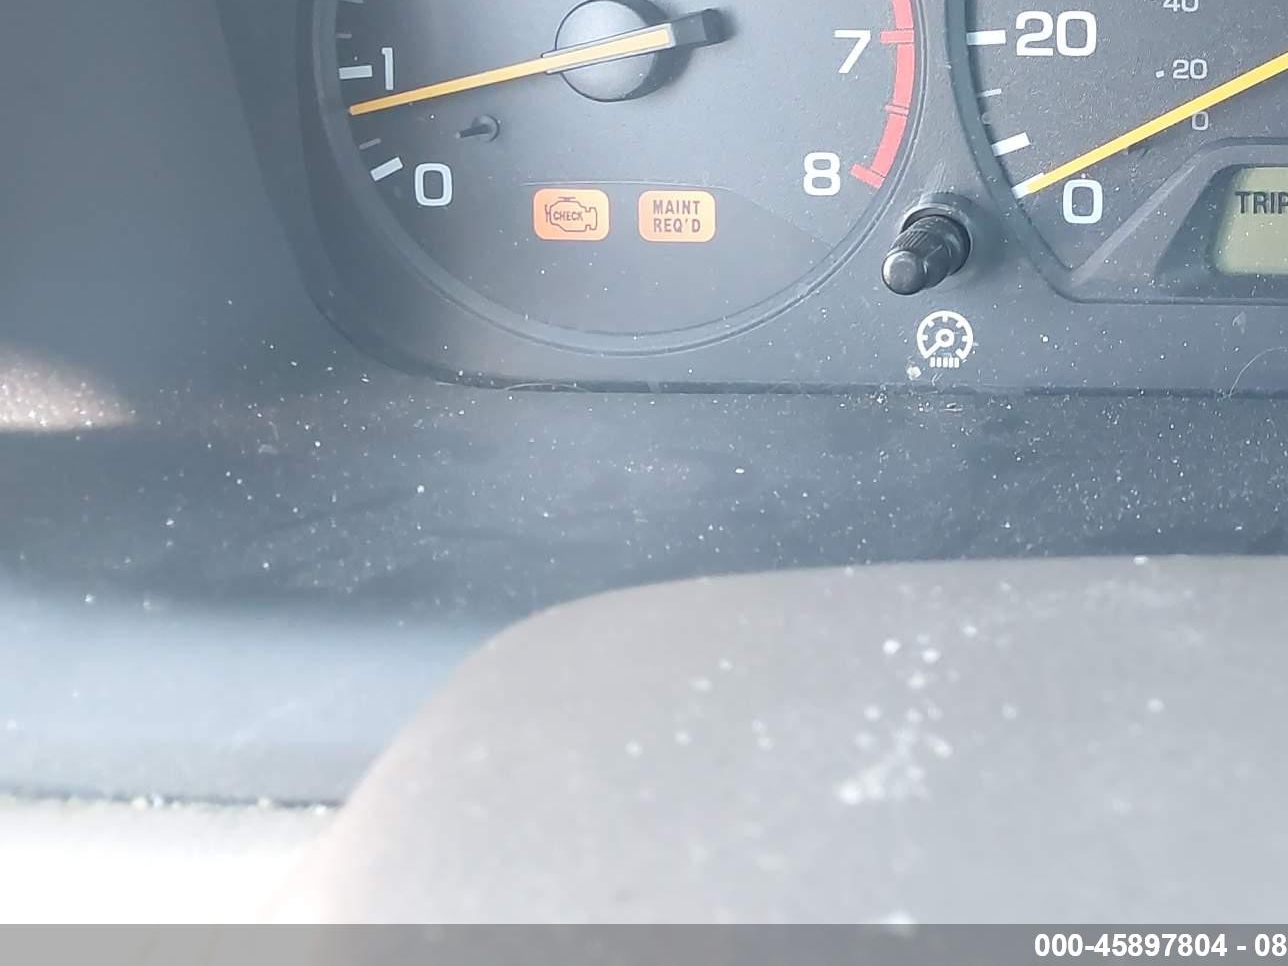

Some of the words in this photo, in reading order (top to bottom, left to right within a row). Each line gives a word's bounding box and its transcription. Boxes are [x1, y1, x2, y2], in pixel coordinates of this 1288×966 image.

[834, 29, 871, 74] 7
[1015, 10, 1097, 57] 20
[381, 47, 394, 91] 1
[1172, 58, 1208, 80] 20
[1190, 110, 1210, 131] 0
[414, 162, 453, 207] 0
[803, 152, 841, 196] 8
[553, 211, 584, 221] CHECK
[653, 199, 701, 215] MAINT
[1061, 178, 1104, 224] 0
[653, 218, 701, 233] REQ'D
